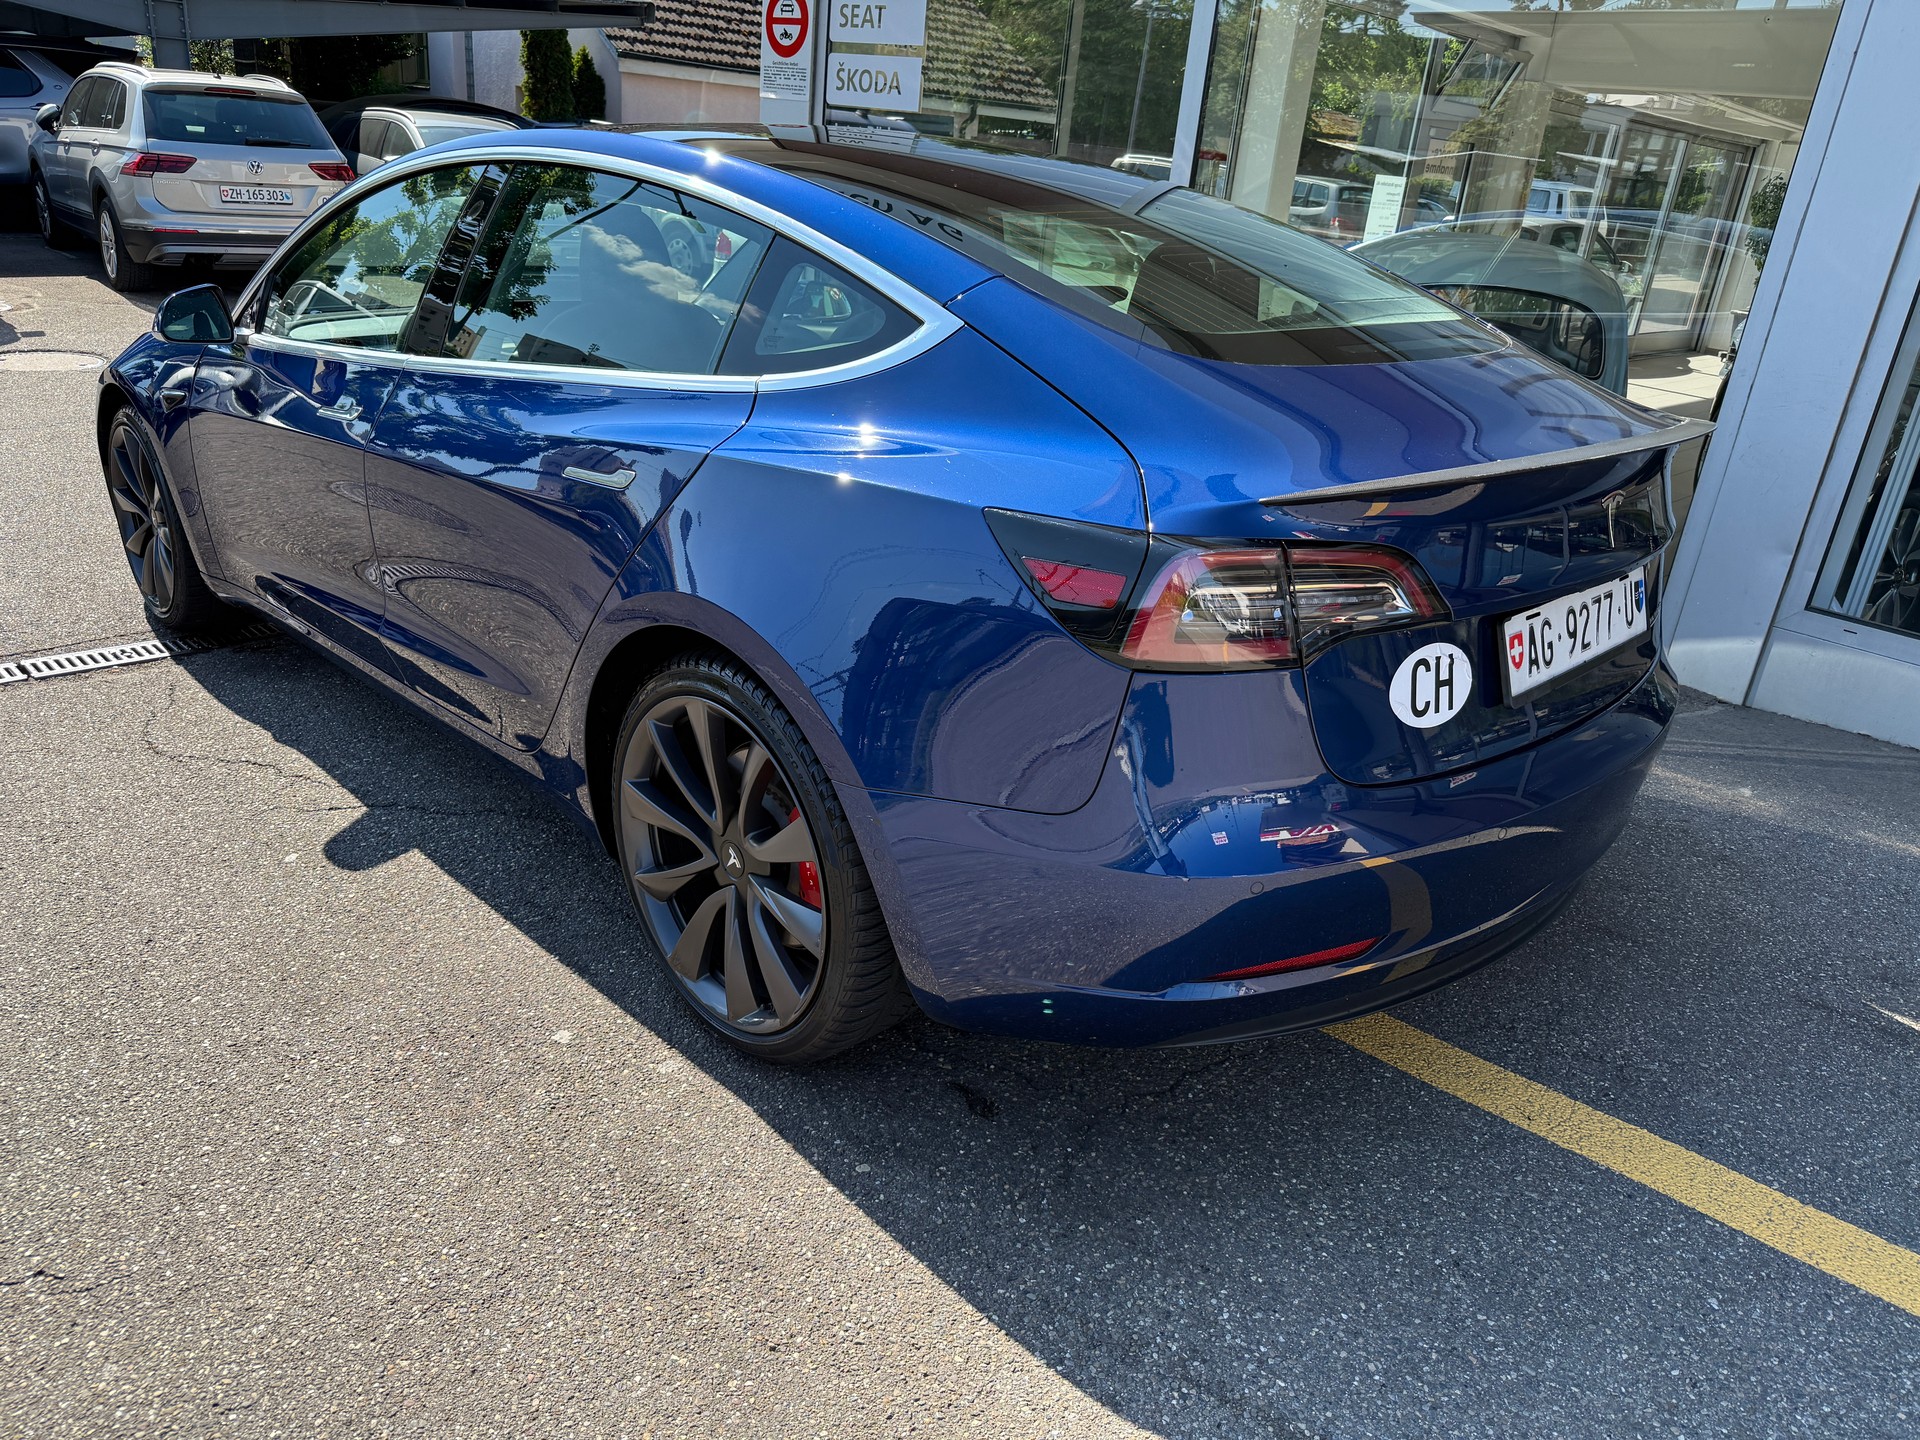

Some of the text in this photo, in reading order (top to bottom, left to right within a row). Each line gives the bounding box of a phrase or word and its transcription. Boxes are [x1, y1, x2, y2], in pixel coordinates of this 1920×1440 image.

[839, 3, 887, 29] SEAT
[835, 61, 902, 96] ŠKODA
[1410, 653, 1455, 719] CH
